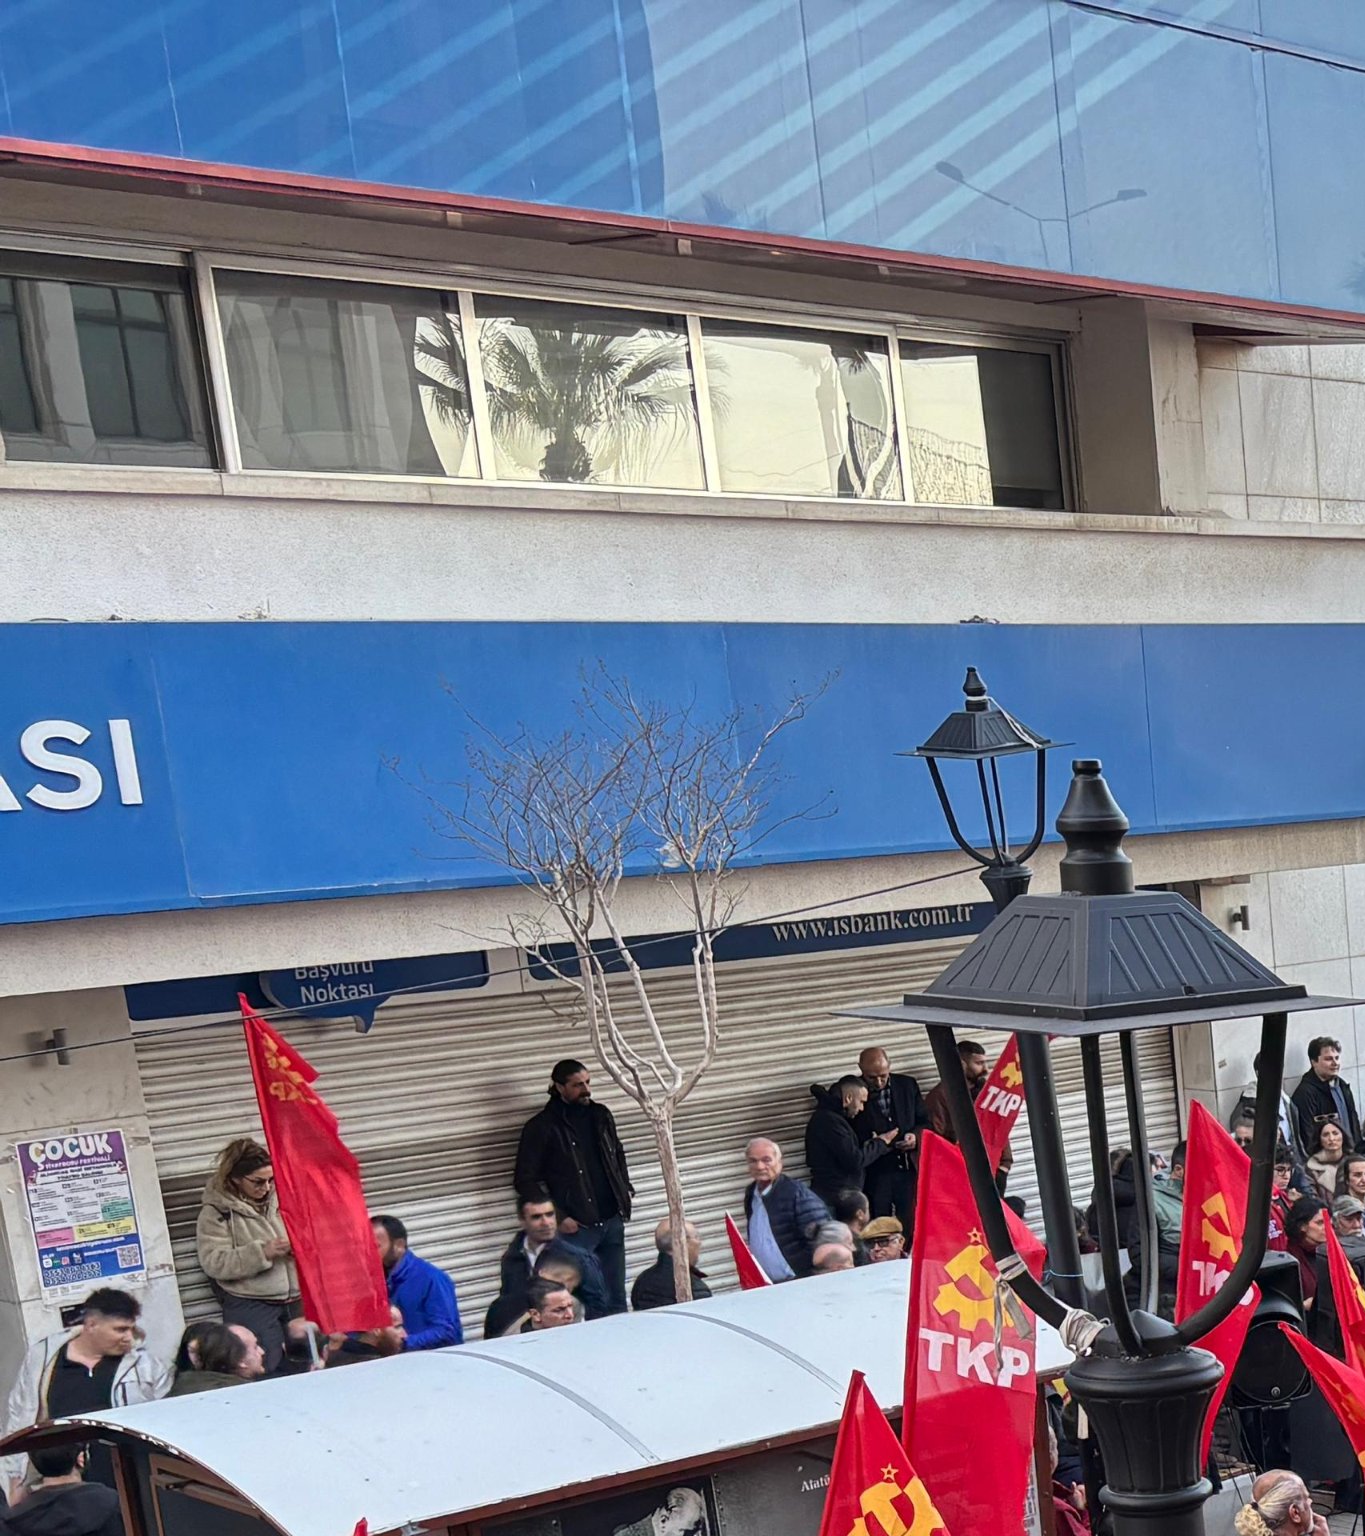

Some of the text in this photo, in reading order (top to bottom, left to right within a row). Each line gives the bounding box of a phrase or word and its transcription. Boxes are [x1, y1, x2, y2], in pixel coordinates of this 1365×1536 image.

[300, 982, 375, 1004] Noktası
[980, 1084, 1025, 1120] TKP
[28, 1133, 113, 1171] ÇOCUK
[919, 1328, 1031, 1389] TKP
[800, 1473, 831, 1493] Atatü
